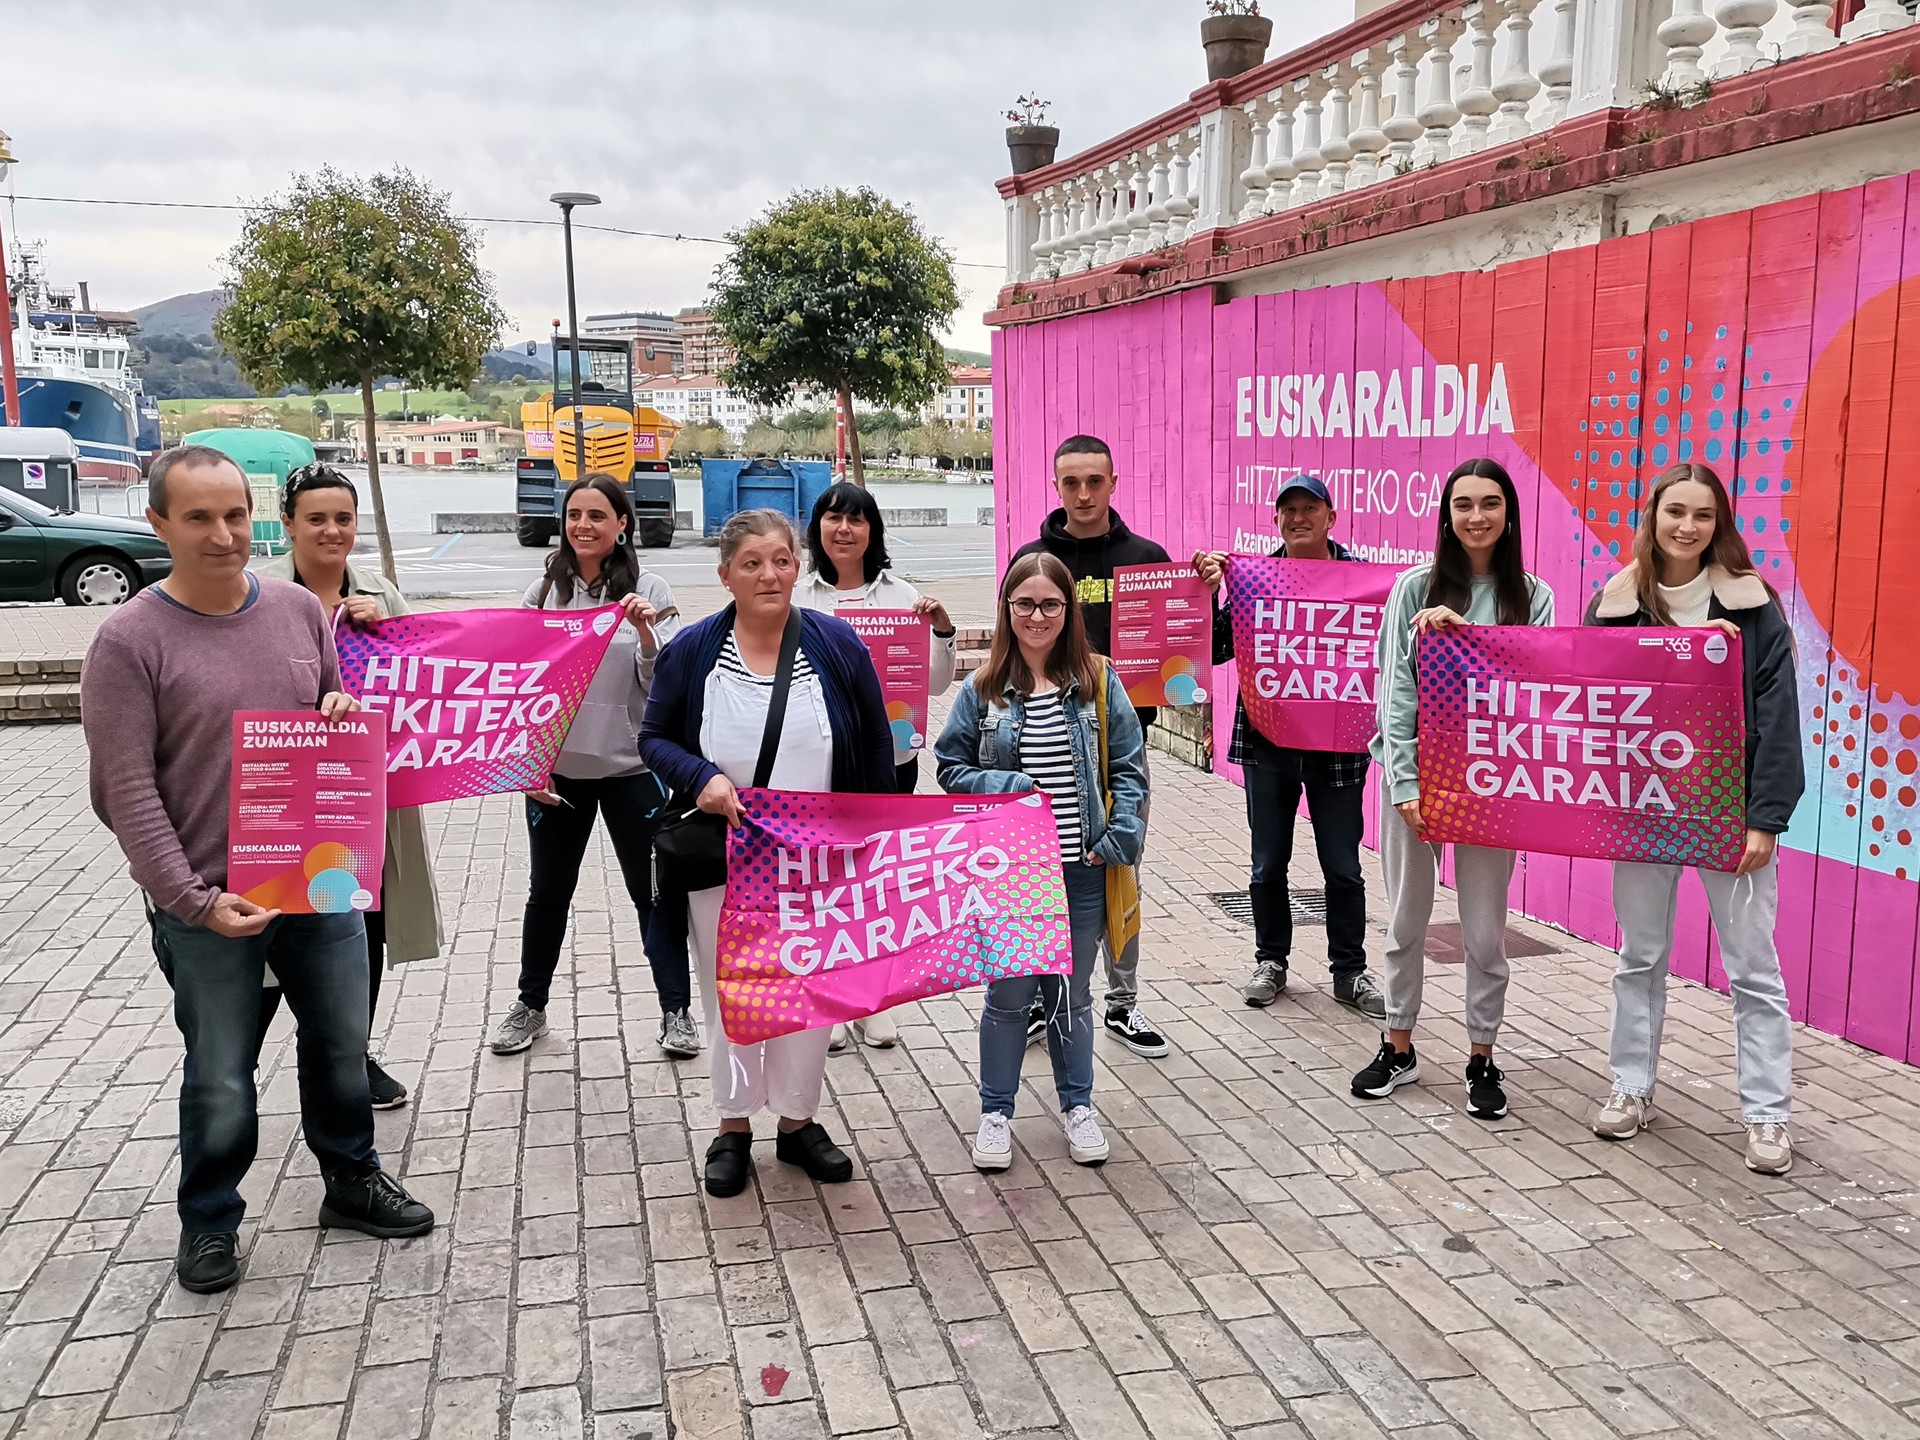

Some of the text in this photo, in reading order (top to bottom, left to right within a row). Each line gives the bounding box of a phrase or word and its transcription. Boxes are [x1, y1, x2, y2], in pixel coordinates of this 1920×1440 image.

[1236, 362, 1516, 438] EUSKARALDIA
[1118, 579, 1173, 593] ZUMAIAN
[1119, 568, 1199, 583] EUSKARALDIA
[853, 626, 895, 636] MAIAN
[1254, 599, 1385, 637] HITZE
[1115, 657, 1160, 666] EUSKARALDIA
[1664, 637, 1692, 653] 365
[363, 655, 550, 696] HITZEZ
[1466, 677, 1653, 725] HITZEZ
[242, 735, 328, 749] ZUMAIAN
[243, 721, 369, 735] EUSKARALDIA
[1467, 718, 1694, 769] EKITEKO
[386, 728, 530, 773] ARAIA
[1465, 759, 1677, 811] GARAIA
[232, 844, 302, 853] EUSKARALDIA
[777, 822, 968, 886] HITZEZ
[777, 845, 1010, 932] EKITEKO
[779, 883, 993, 976] GARAIA
